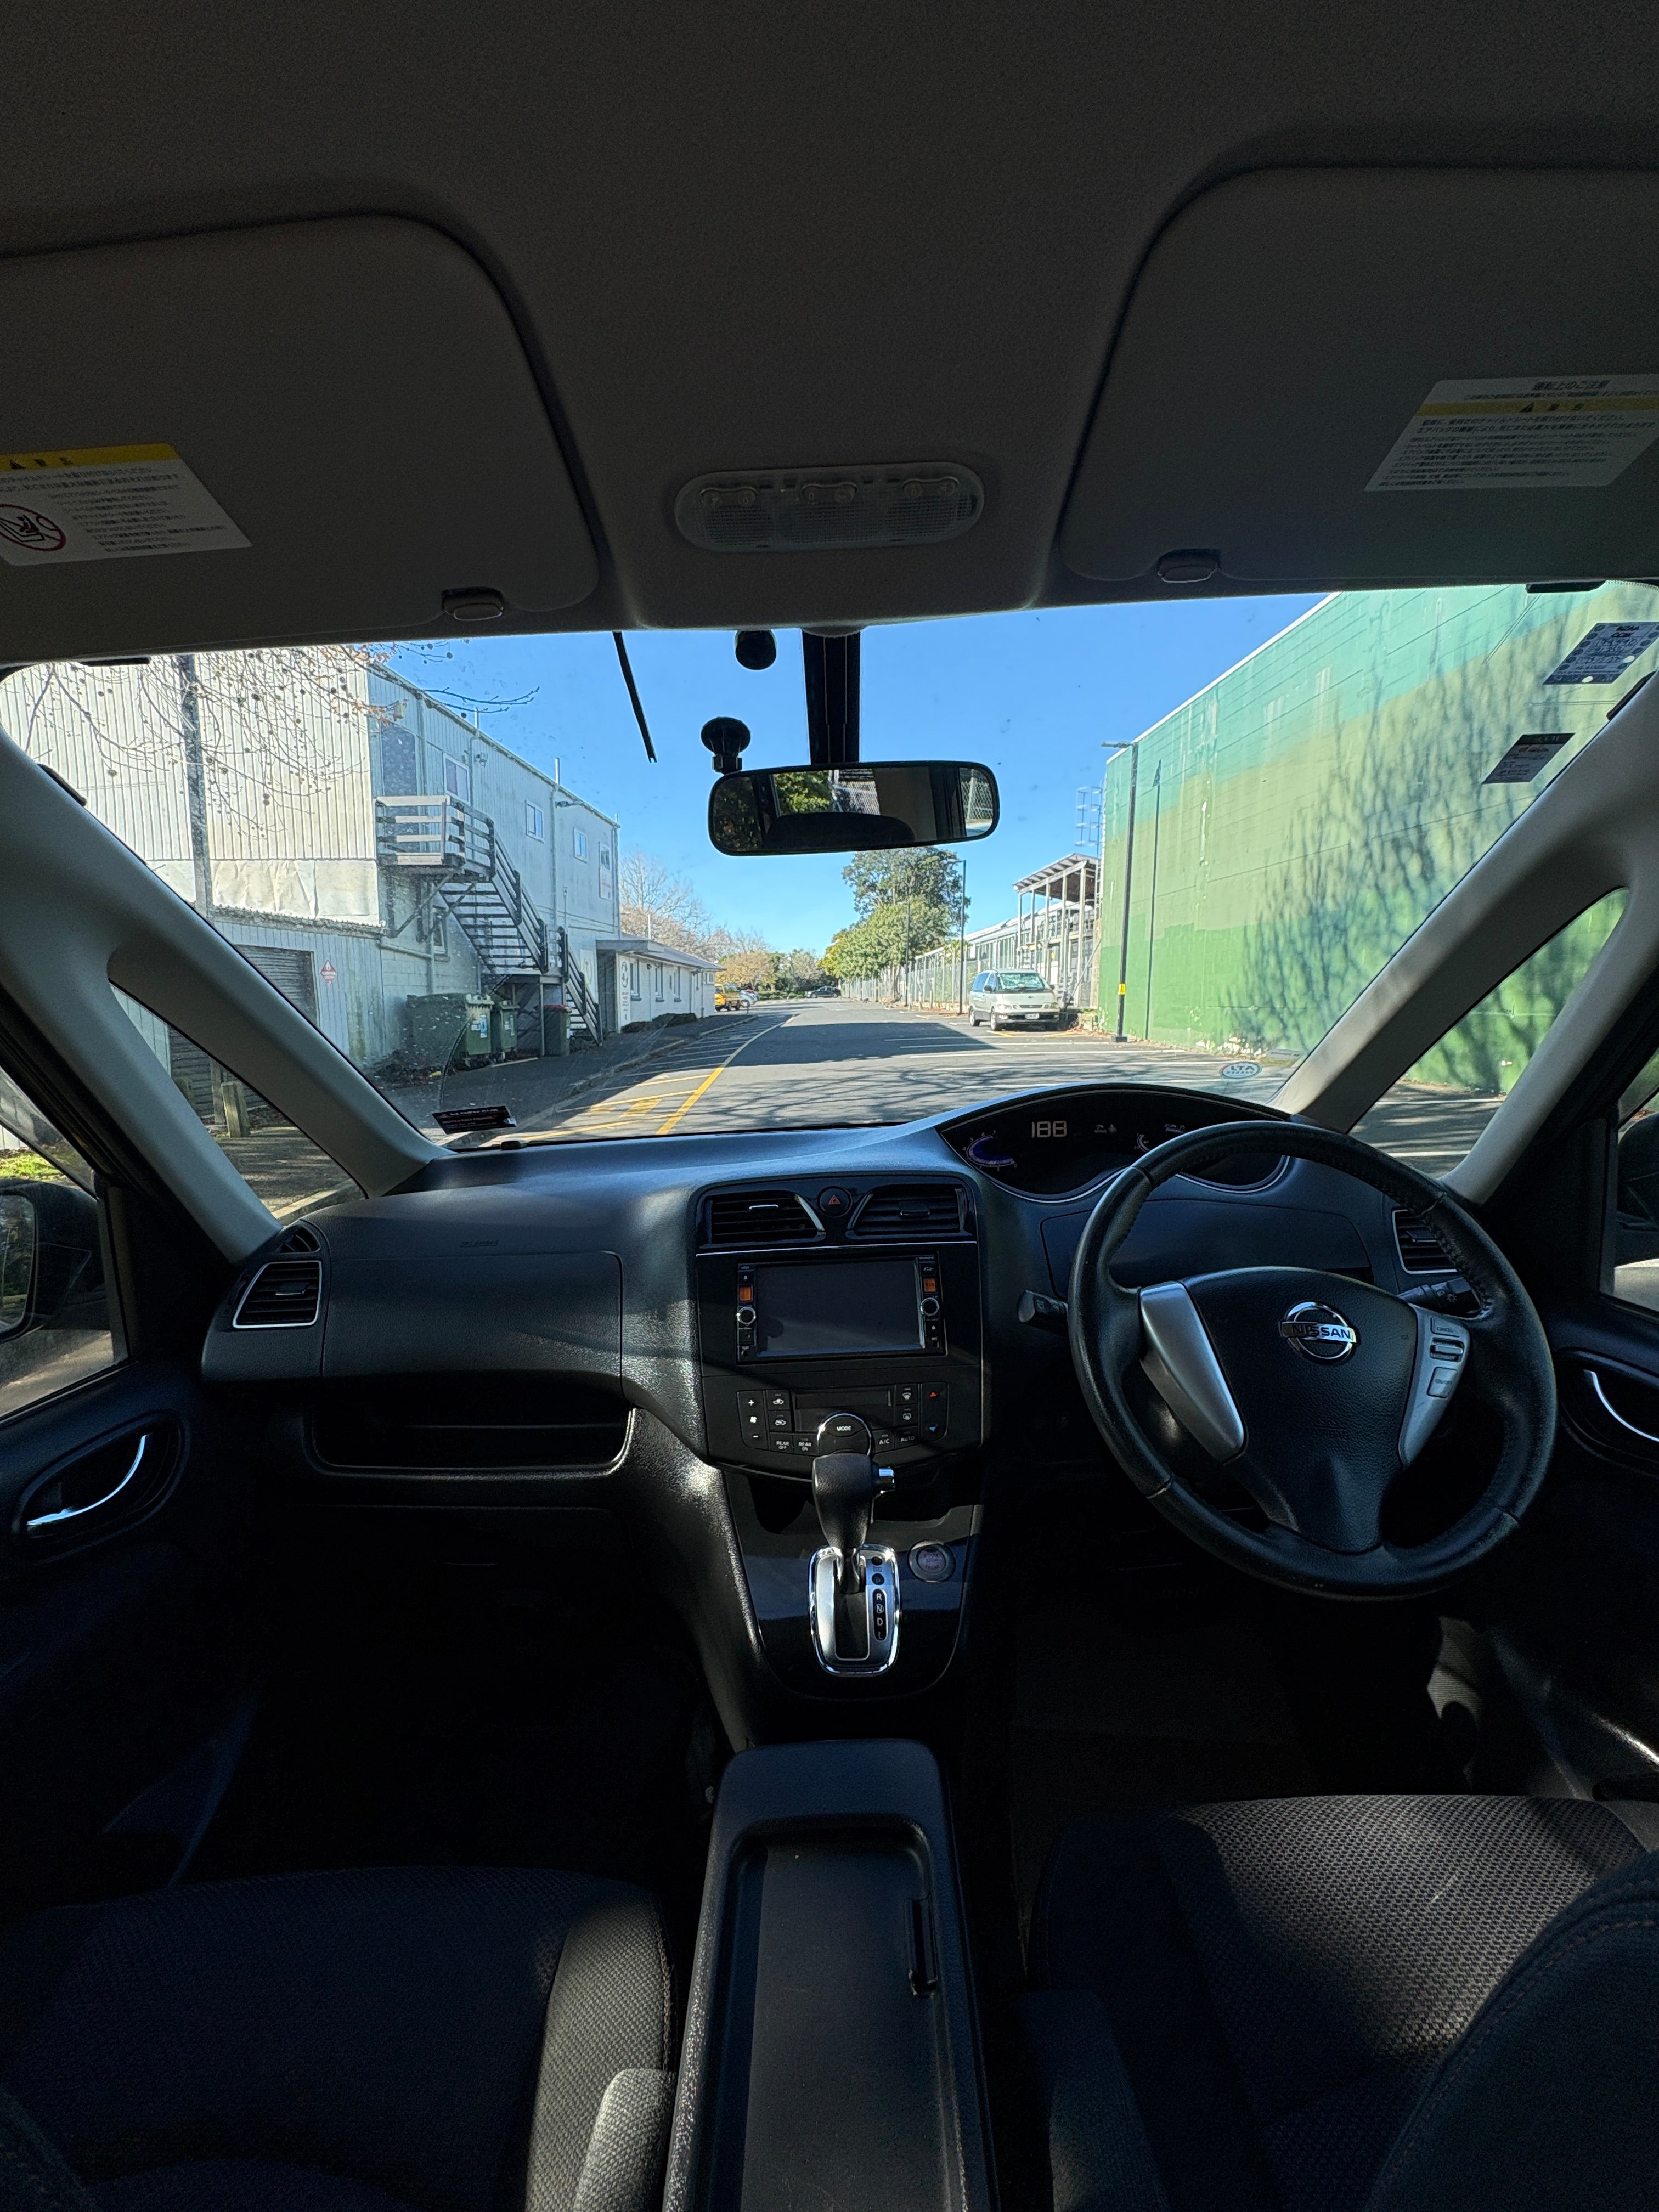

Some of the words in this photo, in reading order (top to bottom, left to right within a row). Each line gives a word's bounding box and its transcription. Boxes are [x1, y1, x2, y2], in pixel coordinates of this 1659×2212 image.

[1031, 1120, 1067, 1138] 188
[1291, 1323, 1351, 1339] NISSAN
[877, 1617, 883, 1626] D
[878, 1630, 883, 1640] L
